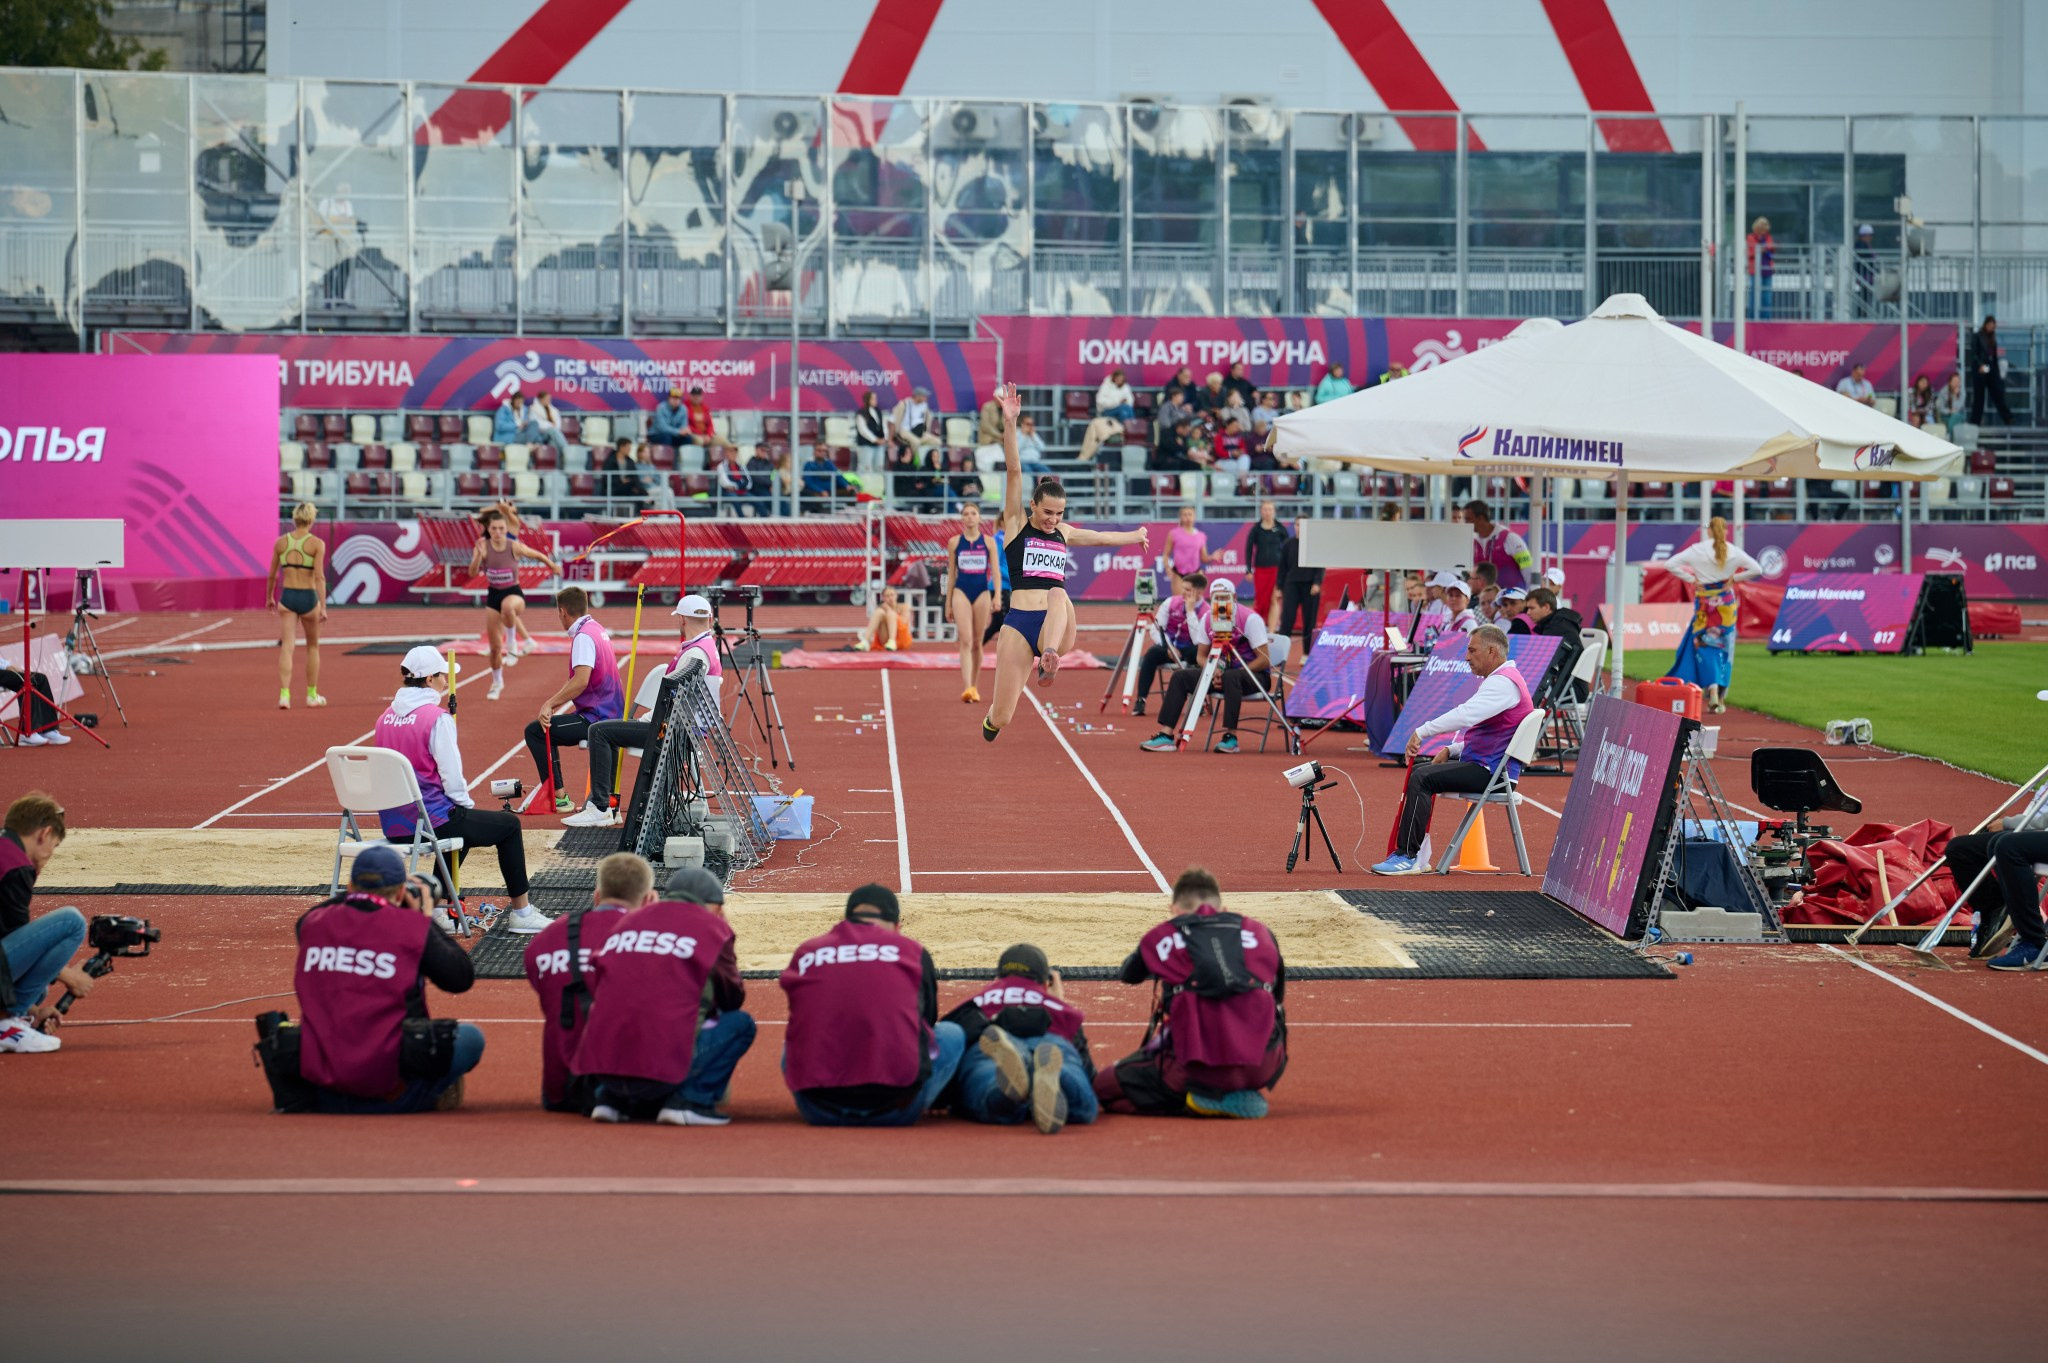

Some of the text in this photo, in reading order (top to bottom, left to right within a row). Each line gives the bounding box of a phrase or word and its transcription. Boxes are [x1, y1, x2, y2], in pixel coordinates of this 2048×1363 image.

[1078, 339, 1325, 365] ЮЖНАЯ ТРИБУНА
[1748, 350, 1849, 367] АТЕРИНБУРГ
[295, 360, 414, 387] ТРИБУНА
[554, 360, 755, 377] ПСБ ЧЕМПИОНАТ РОССИИ
[554, 376, 717, 394] ПО ЛЕГКОЙ АТЛЕТИКЕ
[798, 369, 902, 387] КАТЕРИНБУРГ
[1025, 552, 1066, 571] ГУРСКАЯ
[1112, 555, 1143, 570] ПСБ
[1803, 556, 1856, 570] buysan
[2005, 556, 2036, 569] ПСБ
[1785, 587, 1866, 600] Юлия Макеева
[1317, 631, 1364, 651] Виктория
[1772, 628, 1793, 644] 44
[599, 930, 698, 959] PRESS
[303, 946, 397, 979] PRESS
[535, 948, 596, 979] PRE
[798, 944, 900, 976] PRESS
